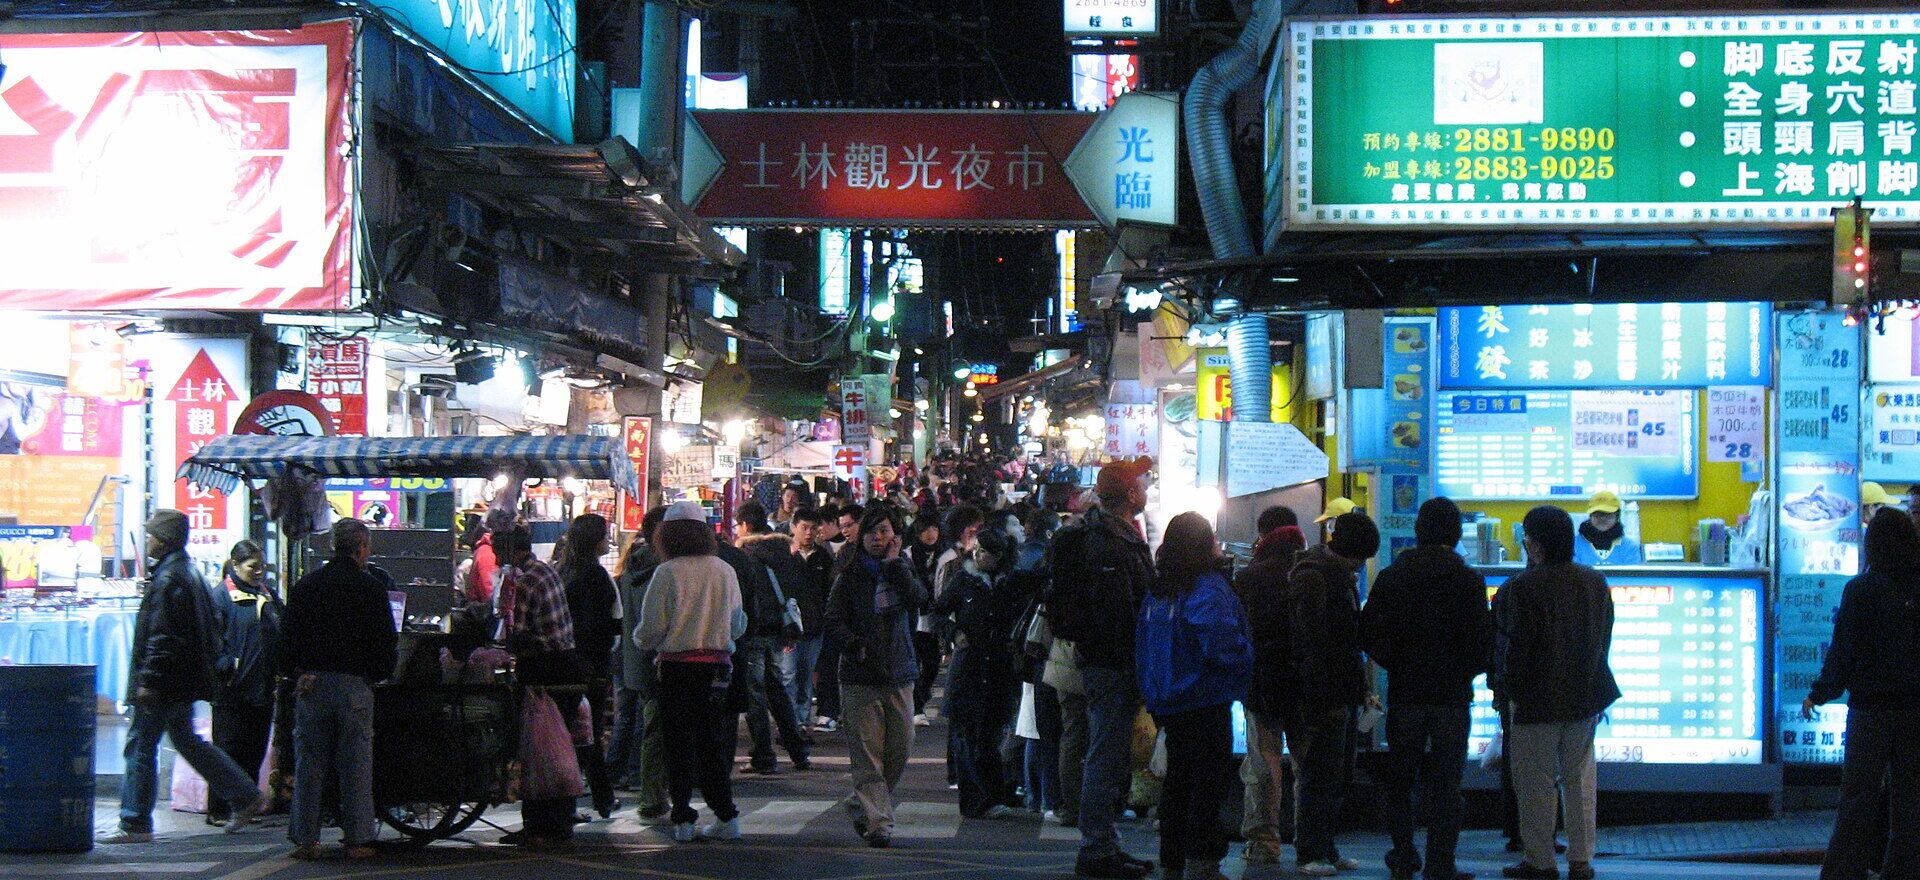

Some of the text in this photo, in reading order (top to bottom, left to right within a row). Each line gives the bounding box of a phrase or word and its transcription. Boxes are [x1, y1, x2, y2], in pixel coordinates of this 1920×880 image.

[1723, 80, 1917, 116] 全身穴道
[1455, 128, 1615, 152] 2881-9890
[1723, 120, 1917, 156] 頭頸肩背
[739, 143, 1049, 192] 士林觀光夜市
[1114, 125, 1155, 211] 光臨
[1455, 156, 1615, 180] 2883-9025
[177, 377, 227, 402] 士林
[1832, 404, 1849, 423] 45
[1642, 422, 1666, 437] 45
[1725, 442, 1752, 459] 28
[1720, 589, 1732, 600] 大
